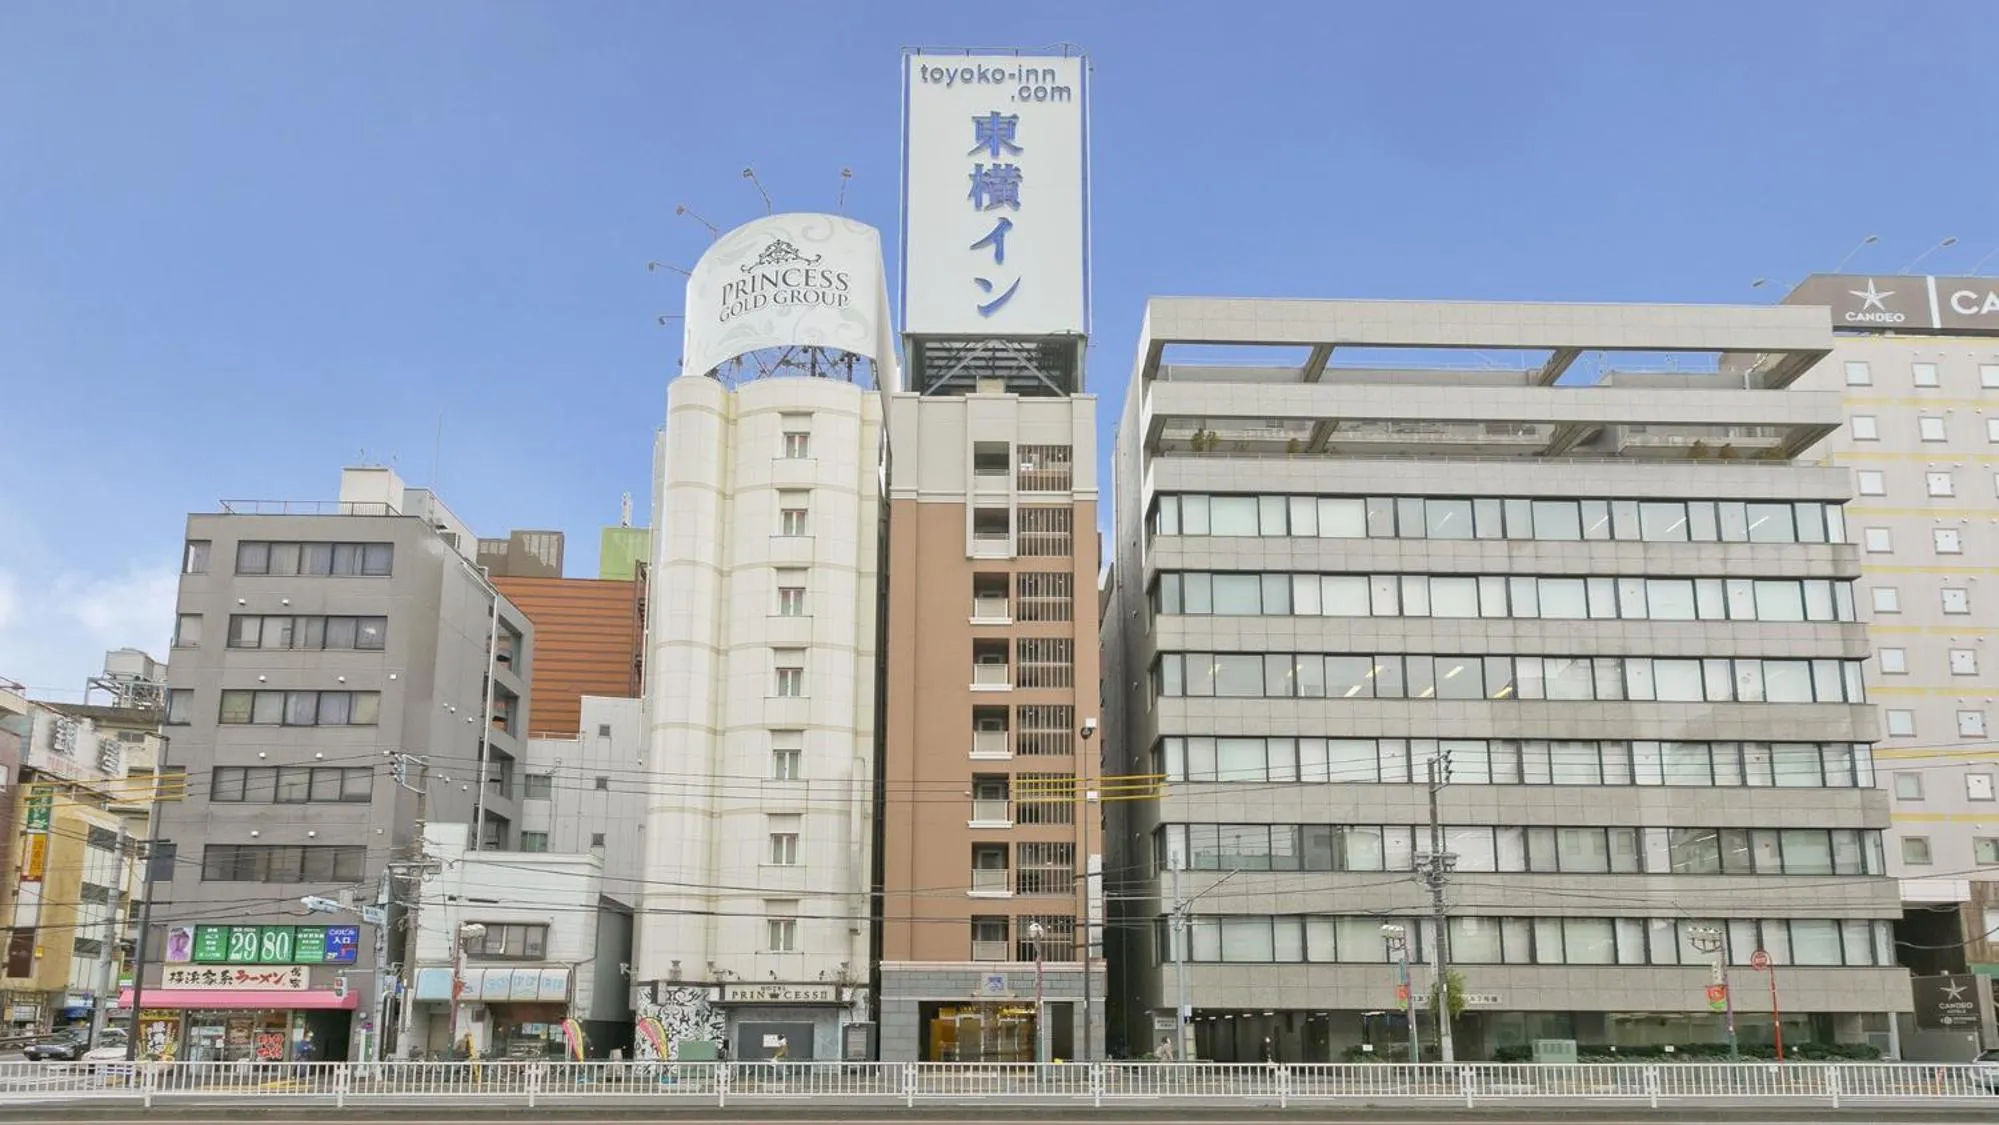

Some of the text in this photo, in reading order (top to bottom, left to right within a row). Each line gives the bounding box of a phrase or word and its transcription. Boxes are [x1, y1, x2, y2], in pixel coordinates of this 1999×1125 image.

[920, 63, 1056, 88] toyoko-inn
[1010, 83, 1072, 103] .com
[967, 111, 1024, 319] 東横イン
[720, 268, 850, 306] PRINCESS
[719, 290, 850, 322] GOLD GROUP
[1844, 311, 1906, 323] CANDEO
[332, 936, 351, 944] 入口
[169, 969, 286, 986] 横浜家系ラーメン
